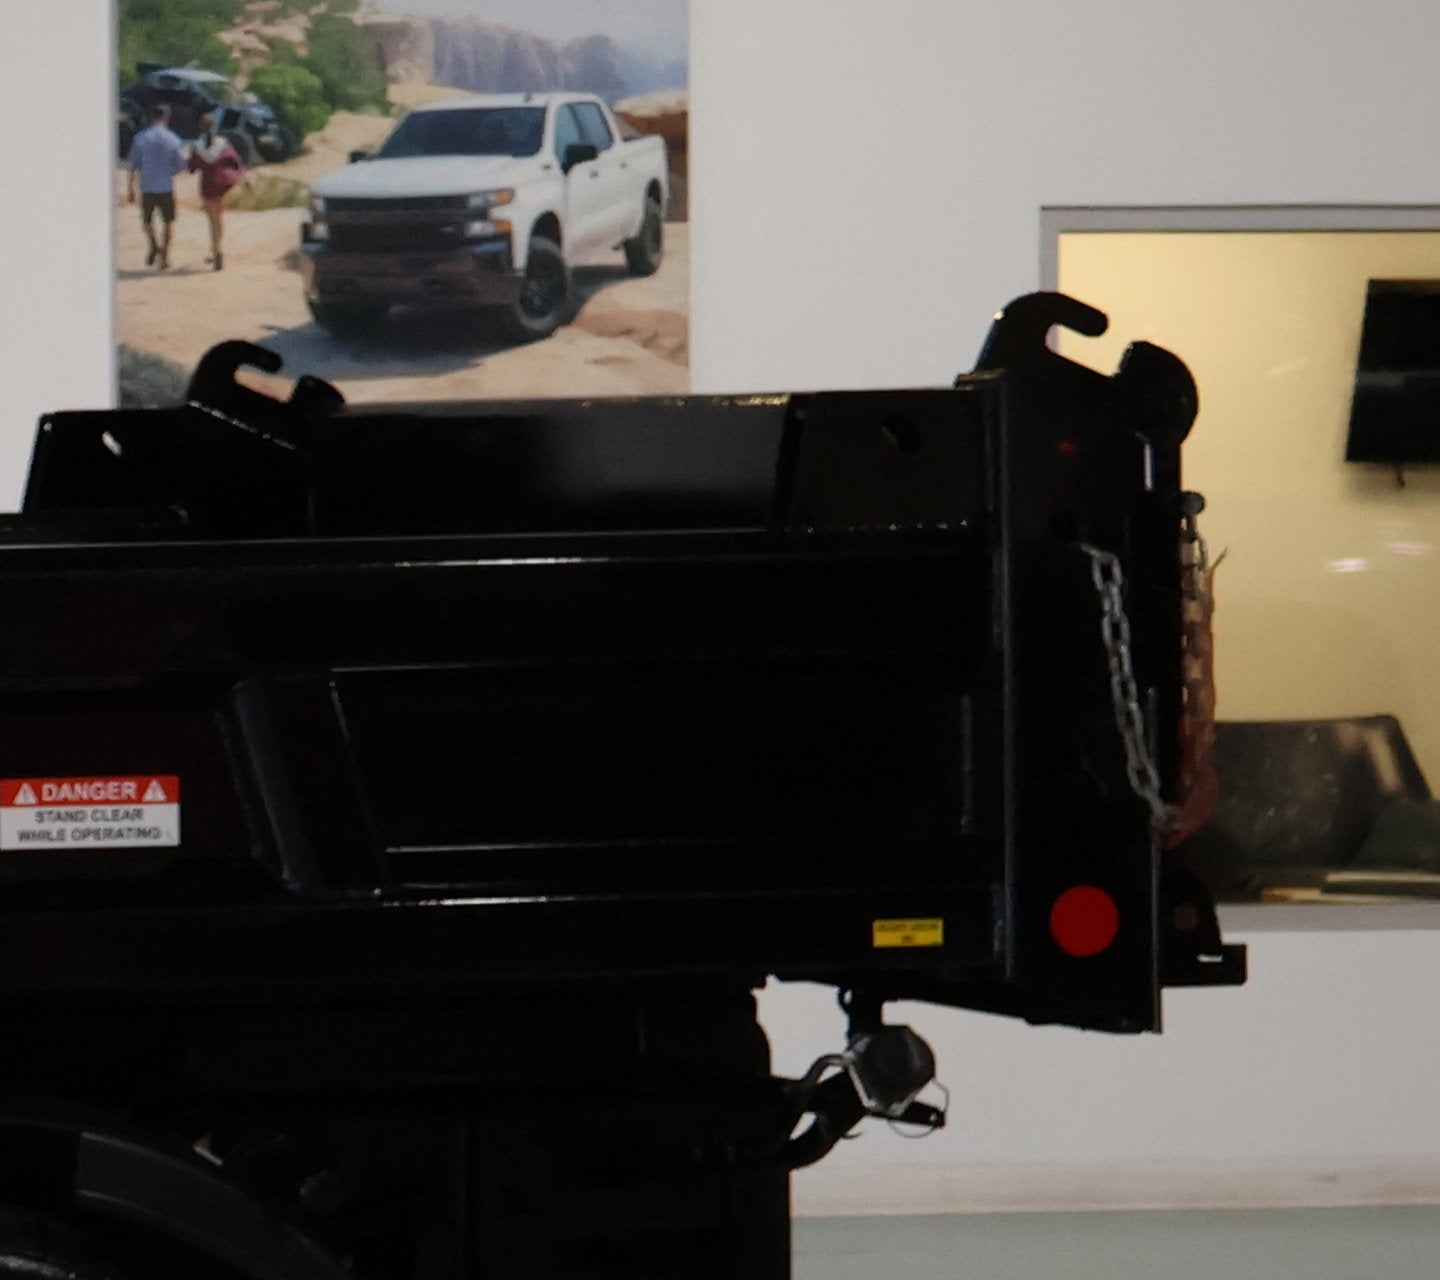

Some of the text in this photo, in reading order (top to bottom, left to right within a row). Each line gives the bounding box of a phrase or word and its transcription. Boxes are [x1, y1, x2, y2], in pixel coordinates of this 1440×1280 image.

[41, 781, 139, 802] DANGER
[34, 808, 144, 824] STAND CLEAR
[17, 827, 163, 843] WHILE OPERATING
